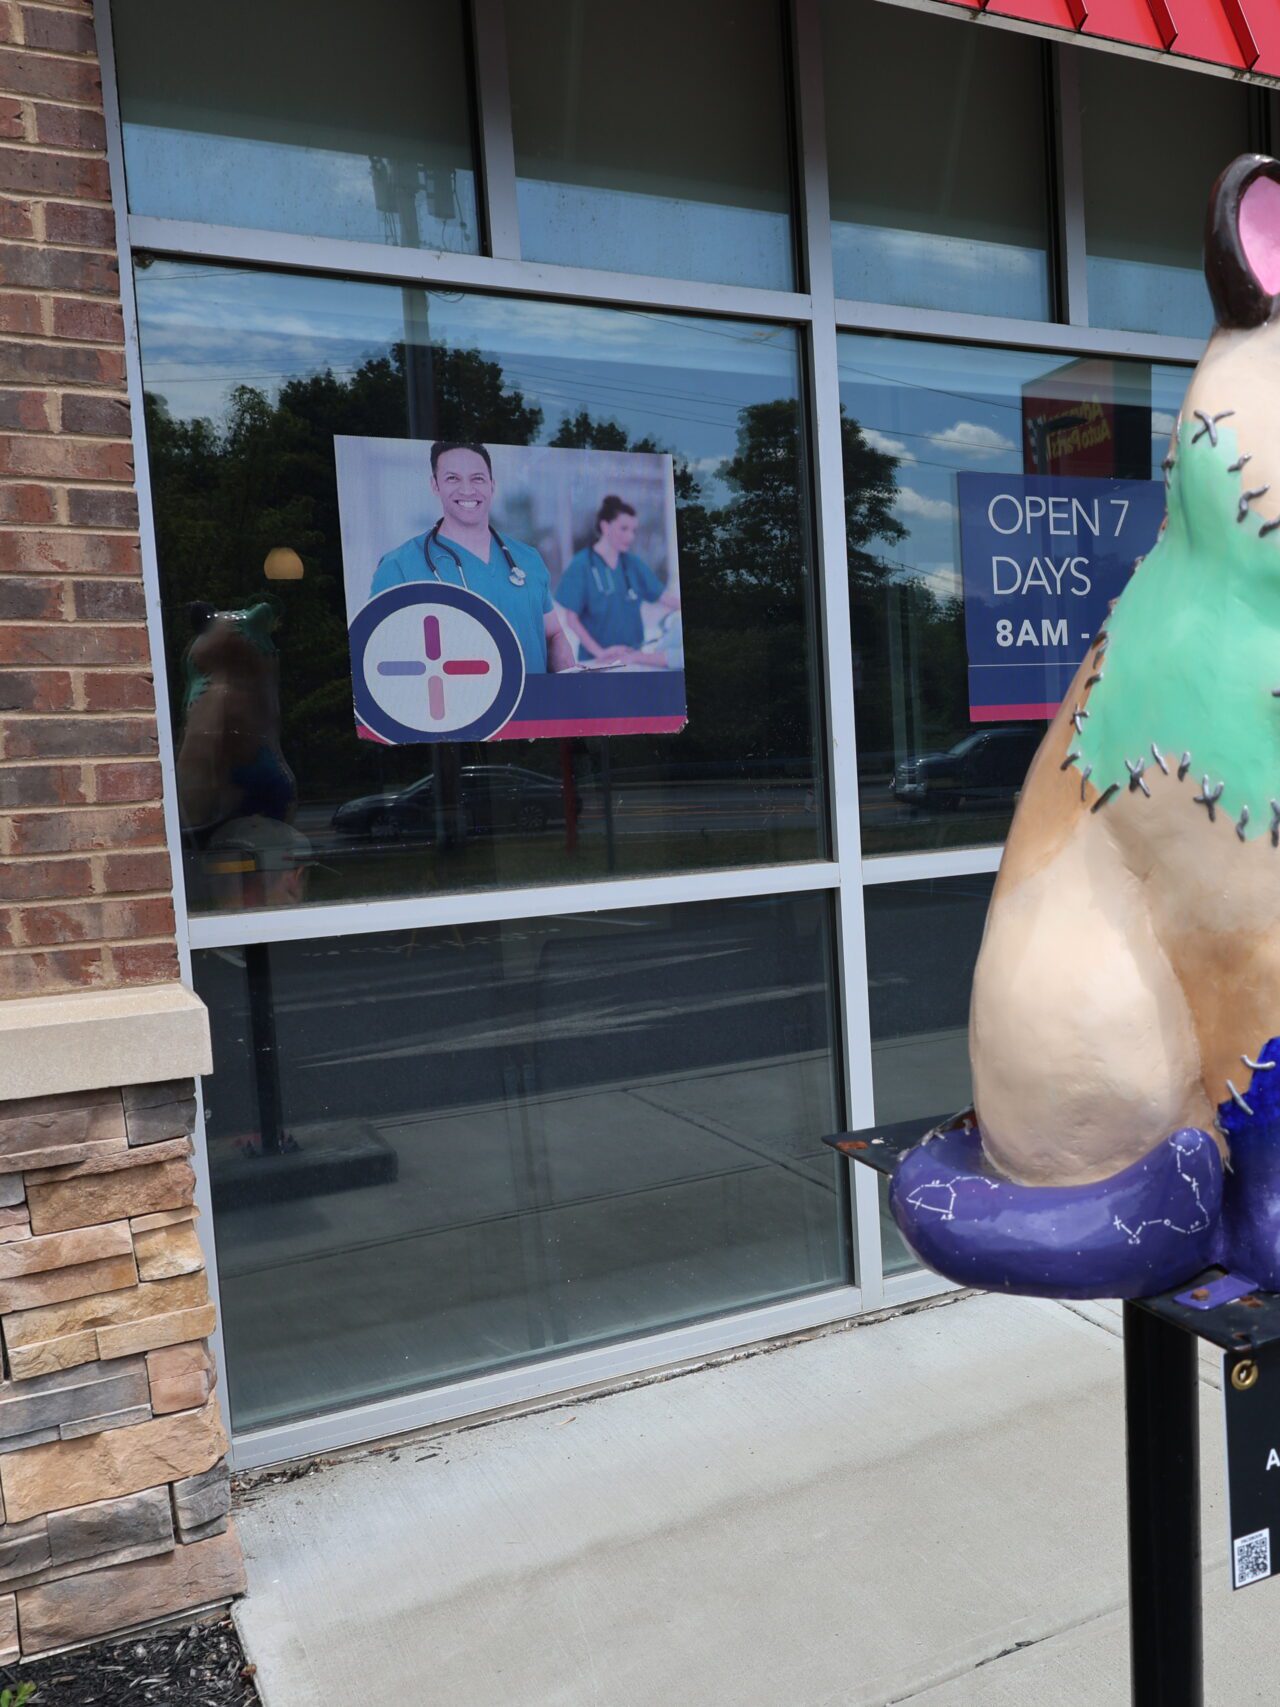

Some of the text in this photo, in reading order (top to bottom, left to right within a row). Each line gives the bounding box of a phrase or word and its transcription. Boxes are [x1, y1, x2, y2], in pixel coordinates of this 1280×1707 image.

[987, 494, 1129, 537] OPEN 7
[991, 556, 1091, 596] DAYS
[995, 619, 1069, 647] 8AM
